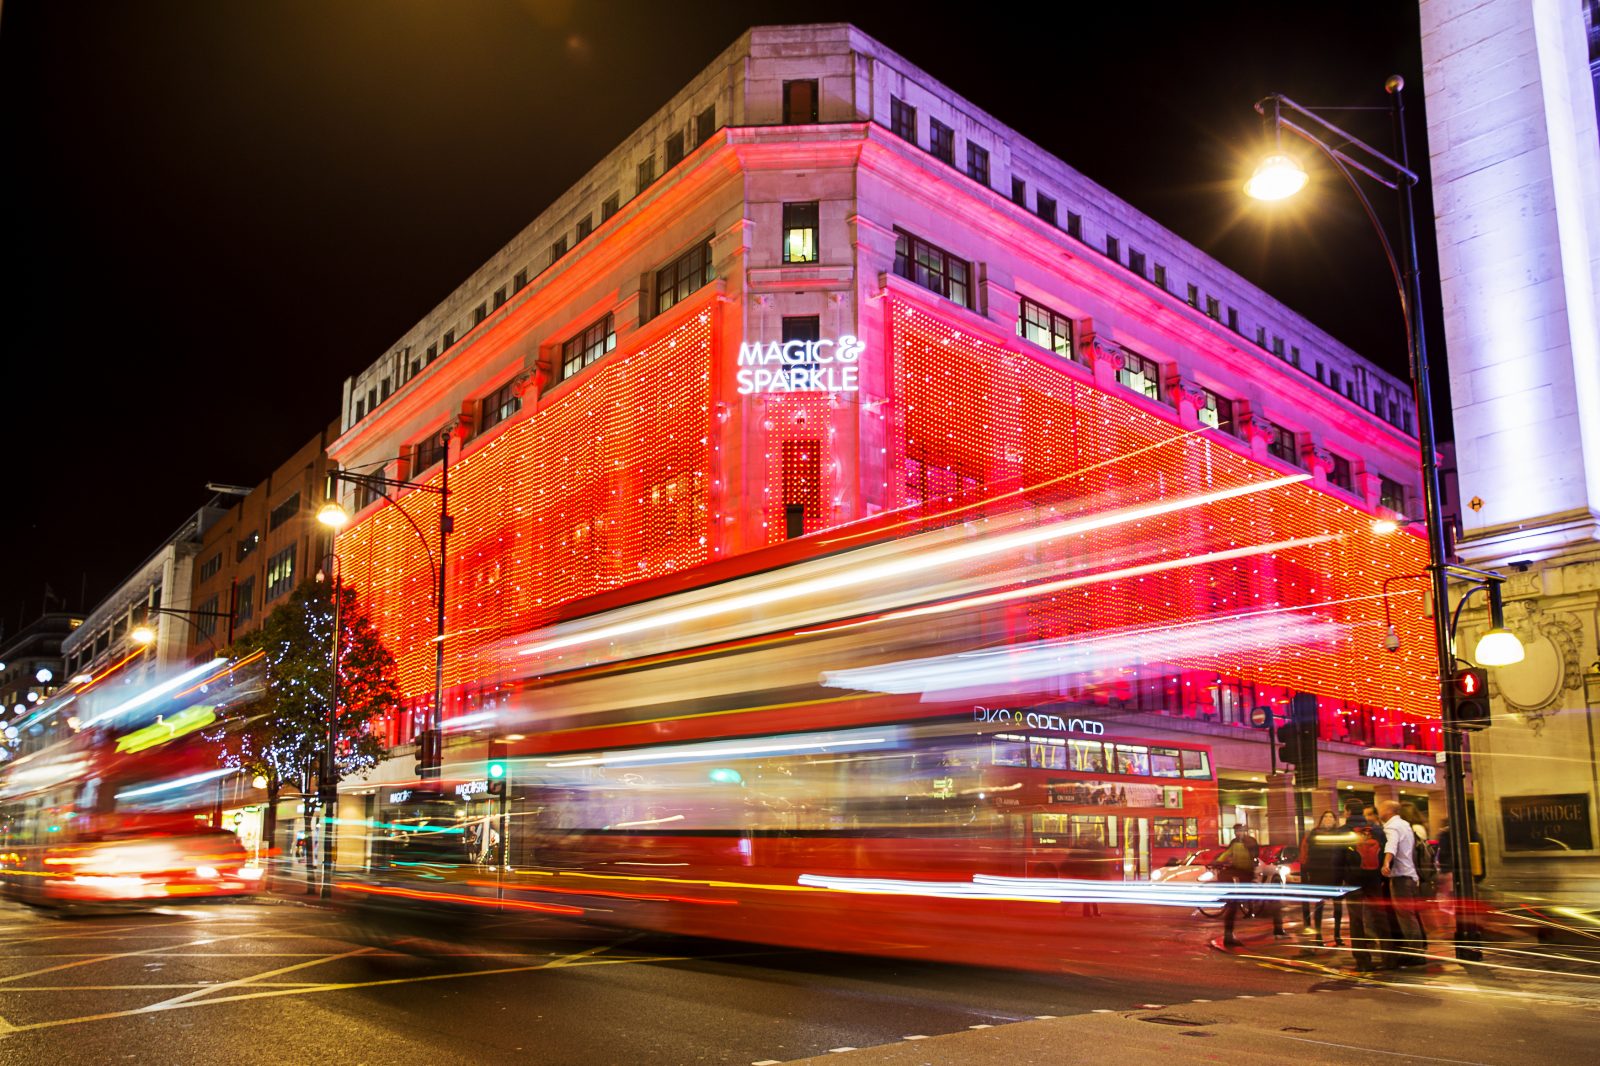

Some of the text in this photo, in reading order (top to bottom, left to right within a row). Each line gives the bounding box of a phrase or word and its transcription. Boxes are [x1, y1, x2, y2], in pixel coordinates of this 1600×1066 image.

[737, 335, 865, 366] MAGIC &
[736, 366, 859, 394] SPARKLE
